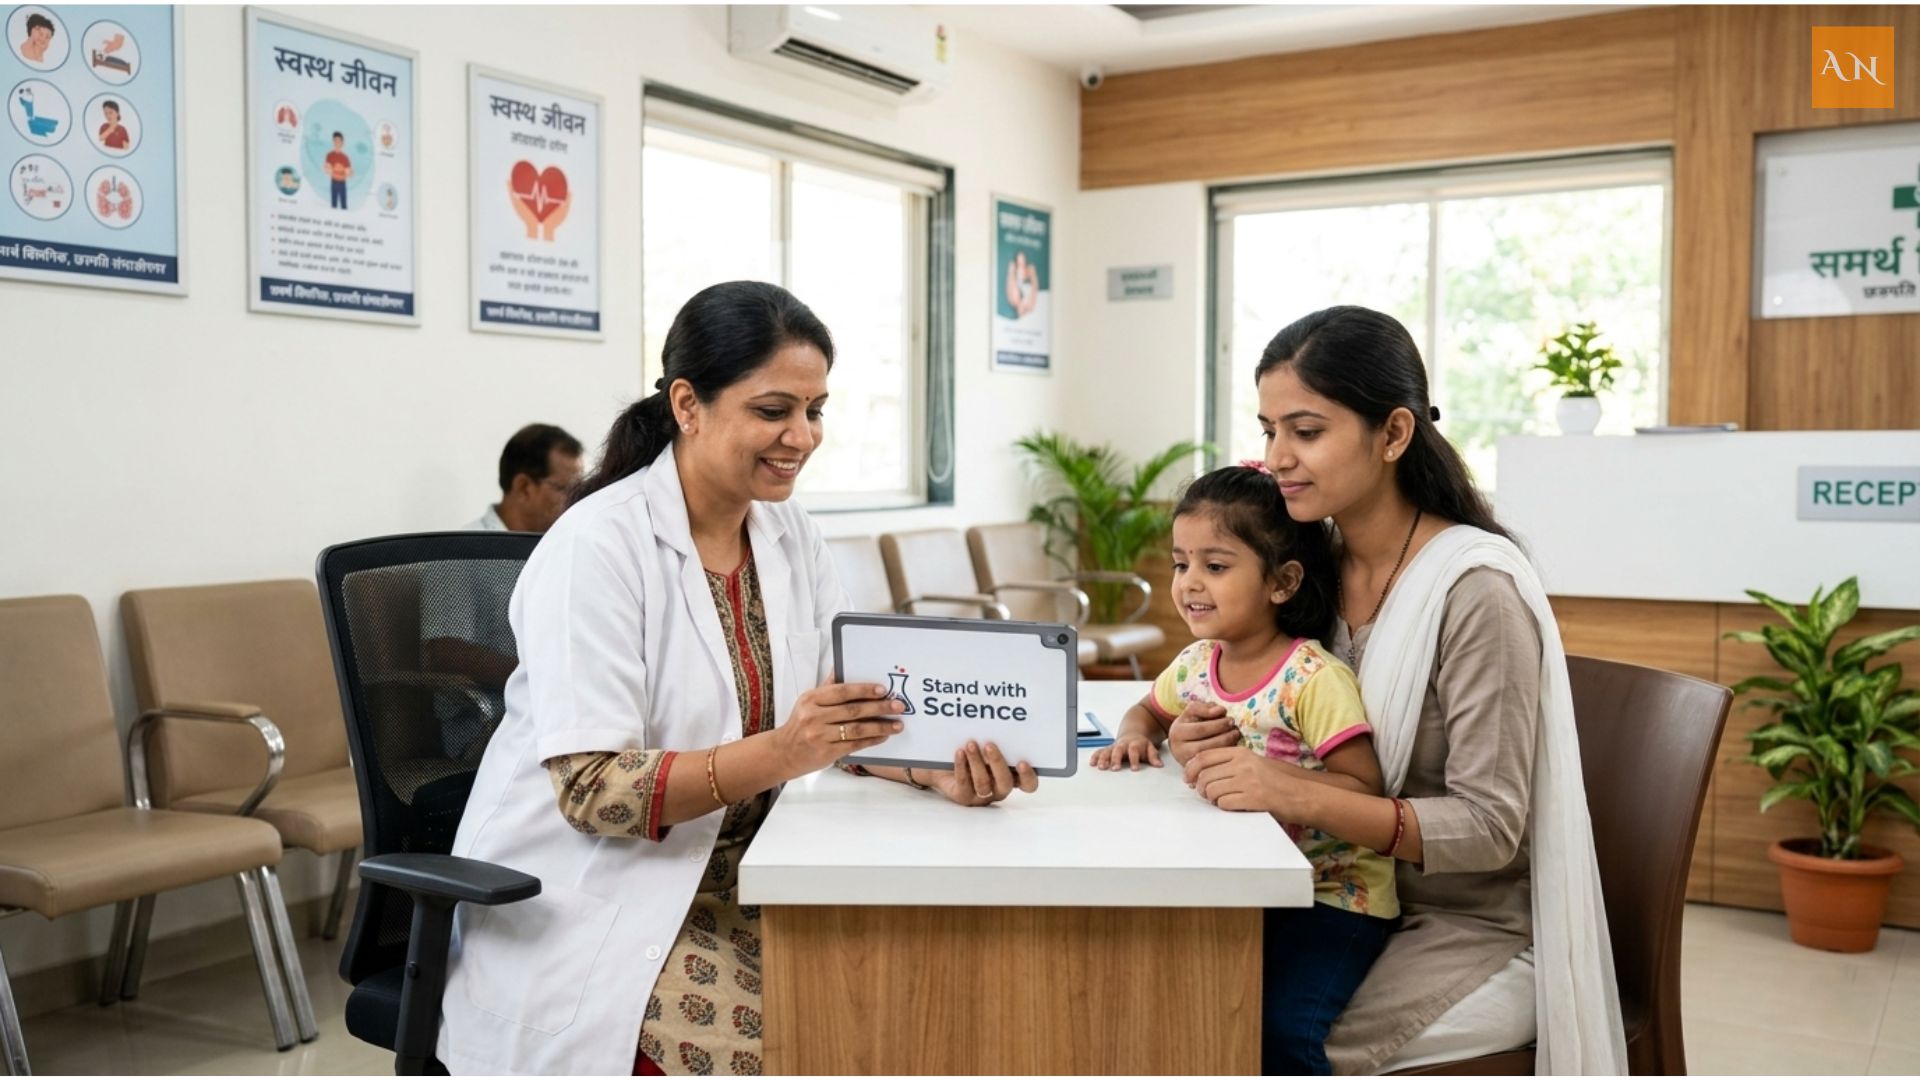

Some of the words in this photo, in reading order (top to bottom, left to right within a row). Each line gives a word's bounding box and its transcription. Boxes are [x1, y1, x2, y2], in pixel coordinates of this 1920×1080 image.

[274, 46, 335, 83] स्वस्थ
[340, 58, 398, 98] जीवन
[489, 94, 537, 125] स्वस्थ
[541, 102, 587, 136] जीवन
[1809, 236, 1905, 279] समर्थ
[1813, 480, 1920, 506] RECEP
[922, 677, 979, 696] Stand
[984, 681, 1027, 698] with
[923, 697, 1028, 722] Science
